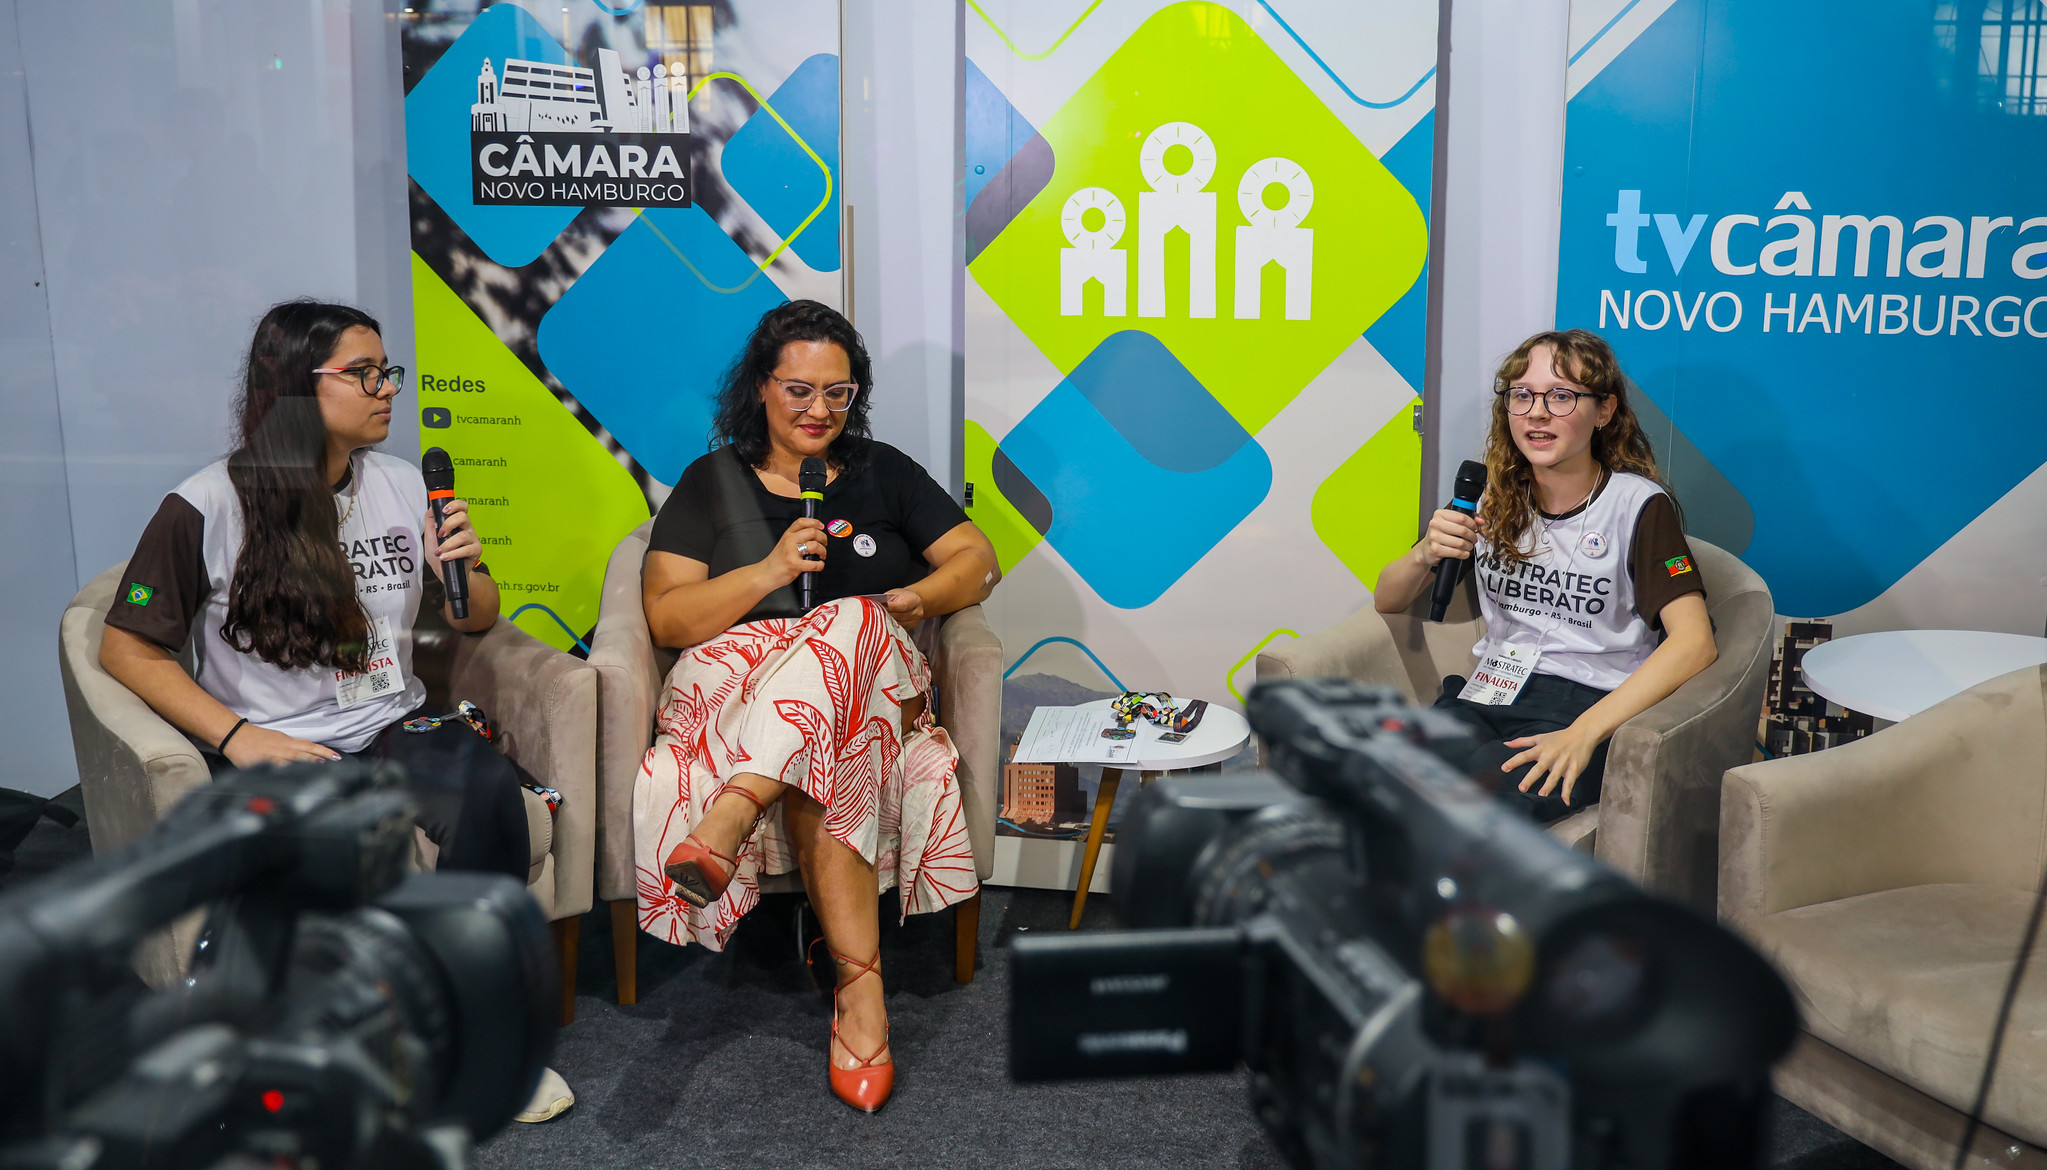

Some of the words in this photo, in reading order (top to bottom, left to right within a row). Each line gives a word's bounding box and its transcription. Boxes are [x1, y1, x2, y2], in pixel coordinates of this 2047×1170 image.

[478, 134, 684, 179] CÂMARA
[480, 182, 545, 199] NOVO
[551, 183, 685, 201] HAMBURGO
[1605, 189, 2047, 279] tvcâmara
[1599, 289, 1743, 332] NOVO
[1763, 292, 2047, 338] HAMBURGO
[421, 374, 486, 393] Redes
[456, 414, 522, 426] tvcamaranh
[339, 535, 411, 559] RATEC
[480, 535, 513, 545] aranh
[350, 555, 415, 579] RATO
[366, 584, 378, 594] RS
[387, 579, 411, 591] Brasil
[497, 580, 560, 594] nh.rs.gov.br
[1487, 573, 1605, 616] LIBERATO
[1499, 602, 1542, 617] amburgo
[1550, 611, 1562, 620] RS
[1568, 617, 1592, 629] Brasil
[335, 657, 394, 682] FINISTA
[1474, 671, 1519, 692] FINALISTA
